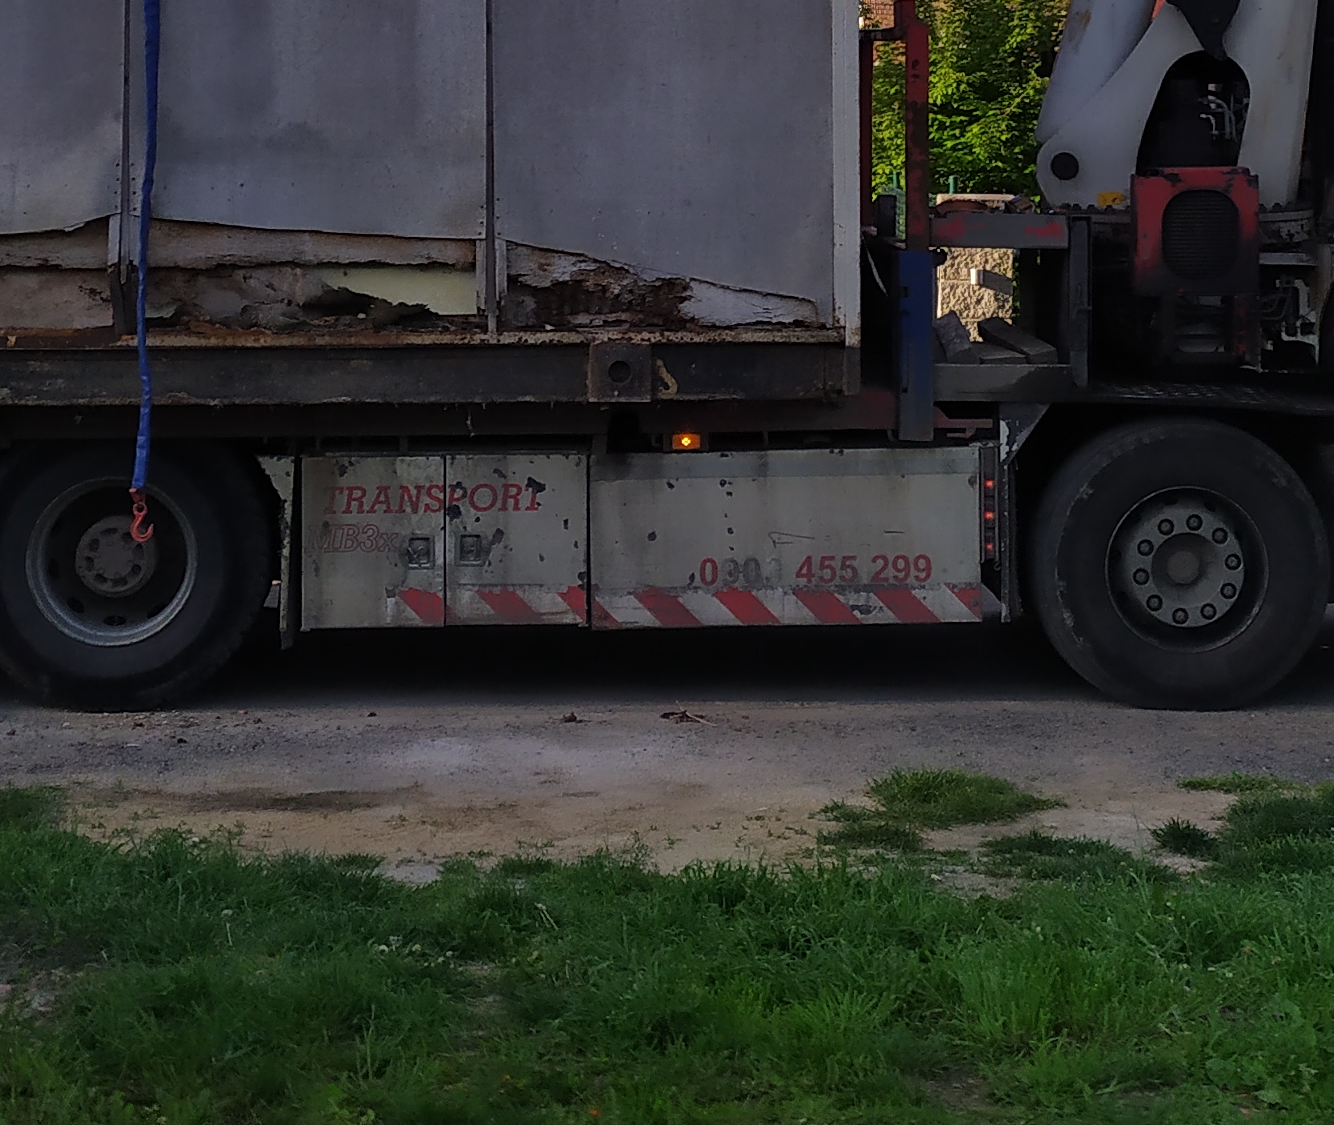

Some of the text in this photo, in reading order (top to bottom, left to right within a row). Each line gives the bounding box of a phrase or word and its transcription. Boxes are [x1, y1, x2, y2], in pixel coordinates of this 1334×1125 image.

[323, 483, 544, 514] TRANSPORT
[795, 555, 858, 584] 455
[871, 554, 932, 583] 299
